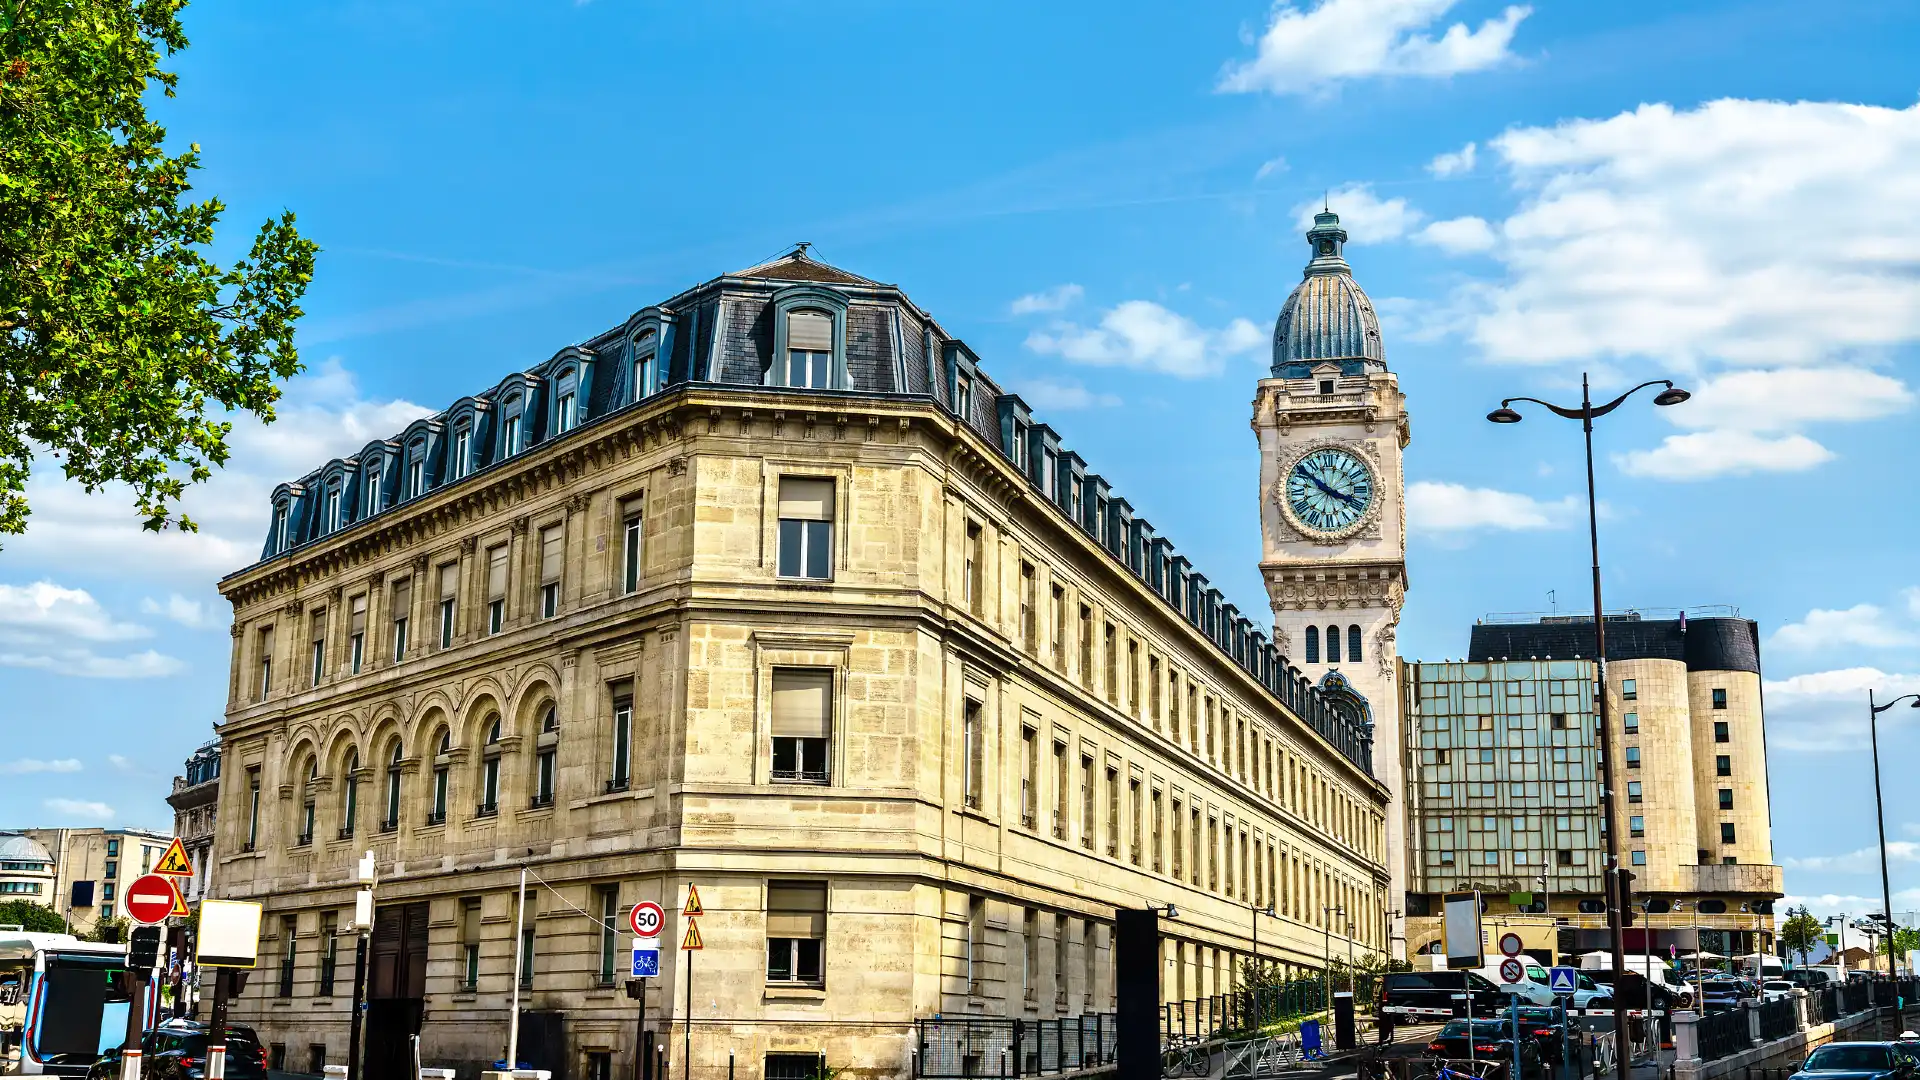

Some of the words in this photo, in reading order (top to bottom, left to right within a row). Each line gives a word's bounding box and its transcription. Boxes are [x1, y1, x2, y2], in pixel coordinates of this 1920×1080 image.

[1306, 459, 1319, 472] XI
[1323, 454, 1333, 467] XII
[1341, 459, 1348, 470] I
[1349, 469, 1362, 480] II
[1354, 486, 1367, 494] III
[1326, 514, 1335, 528] VI
[1341, 511, 1351, 522] V
[638, 913, 657, 926] 50
